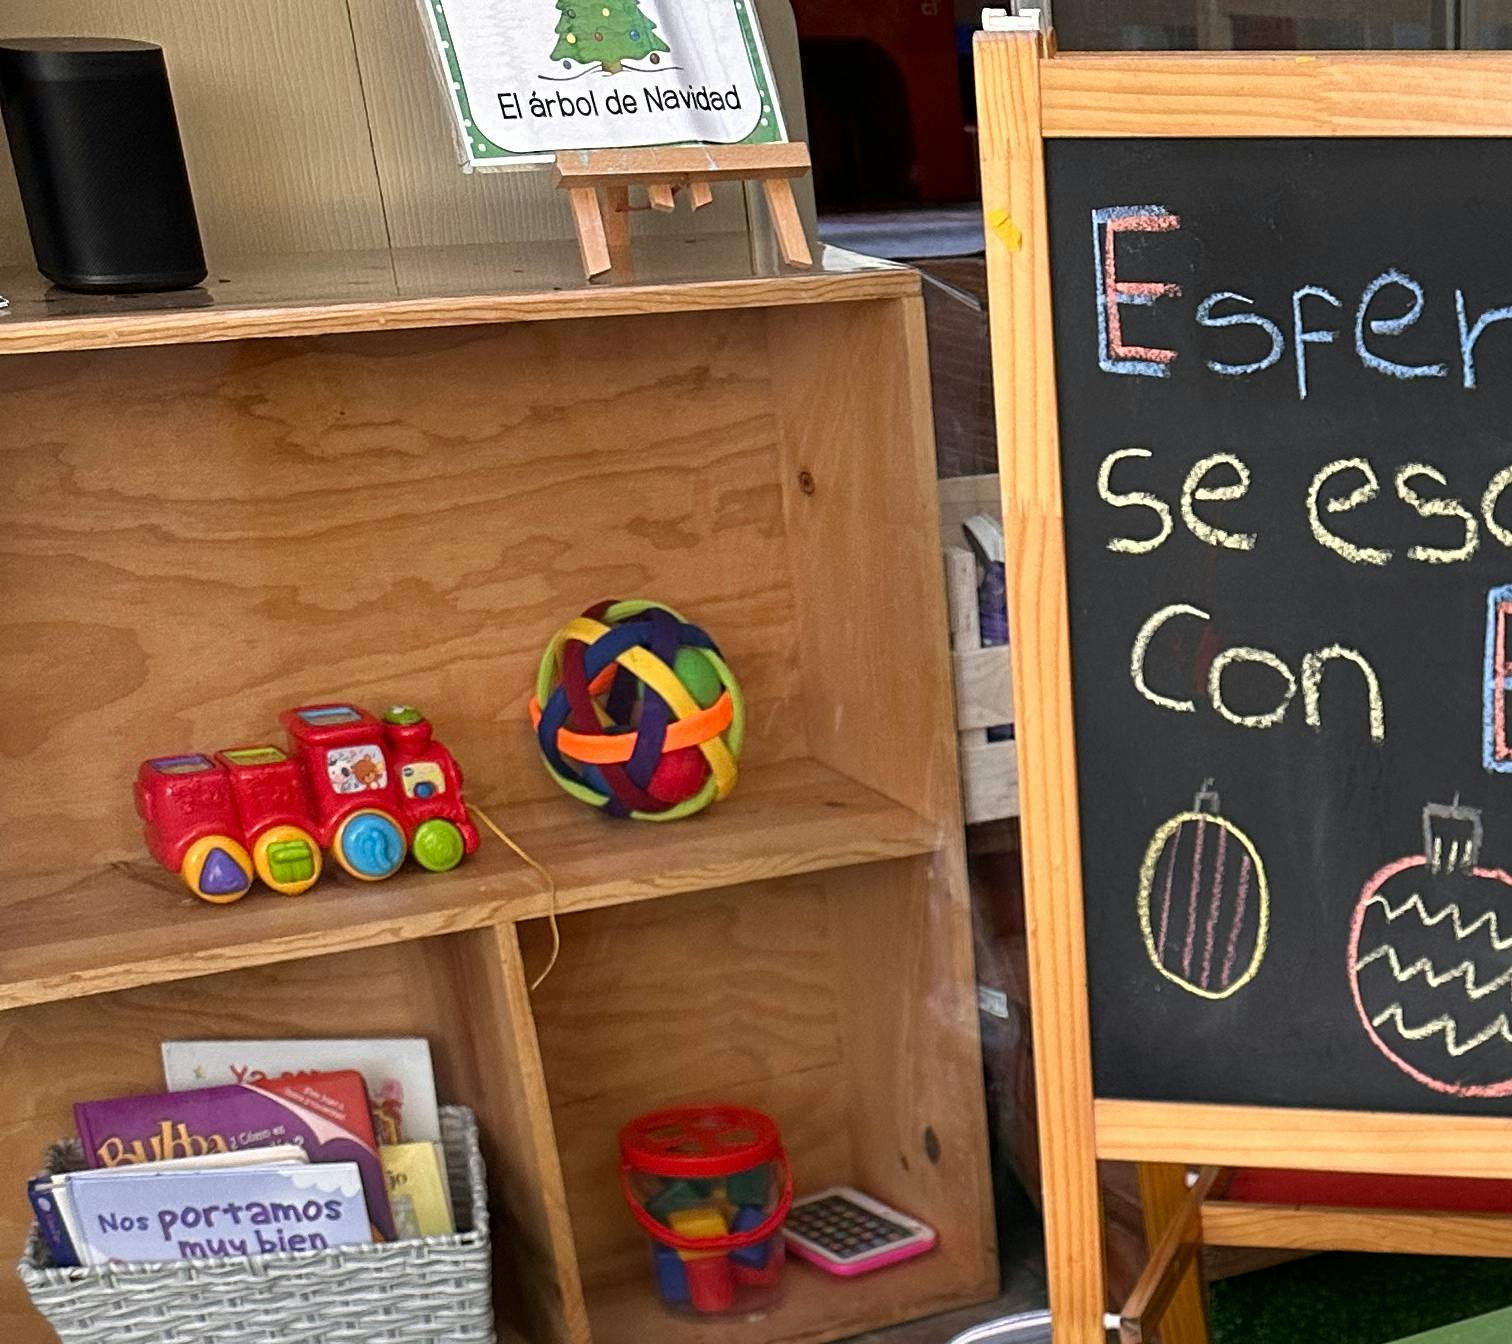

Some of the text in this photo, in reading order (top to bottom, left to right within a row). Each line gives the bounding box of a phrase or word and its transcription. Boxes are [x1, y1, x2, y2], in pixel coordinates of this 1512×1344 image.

[497, 84, 742, 119] El árbol de Navidad
[1097, 447, 1258, 555] se
[97, 1212, 150, 1234] Nos
[157, 1199, 343, 1242] portamos
[177, 1228, 330, 1258] muy bien
